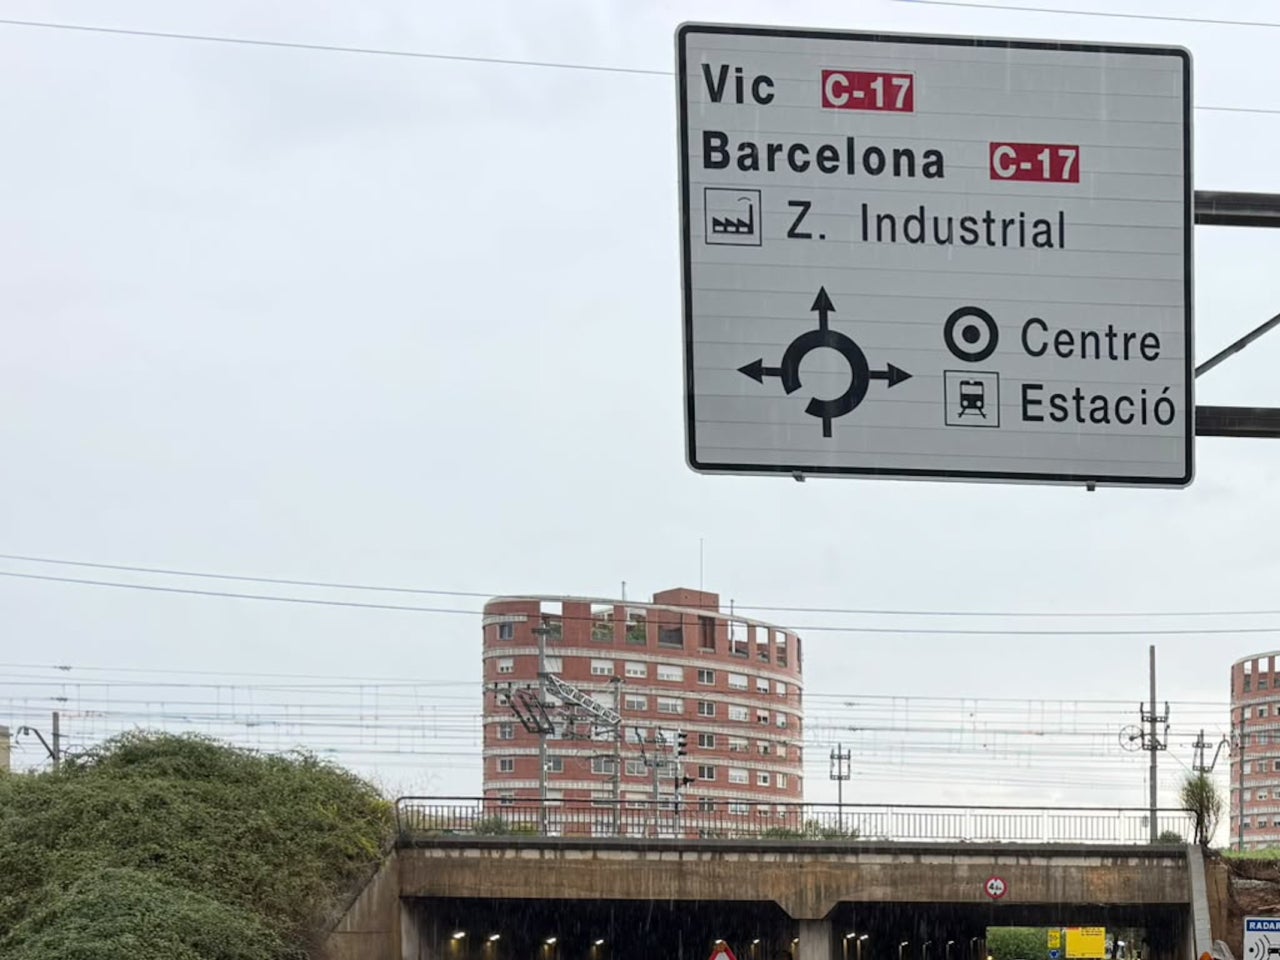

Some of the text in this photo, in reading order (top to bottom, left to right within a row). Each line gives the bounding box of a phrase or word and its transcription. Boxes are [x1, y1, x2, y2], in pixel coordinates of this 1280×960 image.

[701, 63, 911, 109] Vic C-17
[702, 130, 1077, 181] Barcelona C-17
[786, 200, 1065, 249] Z. Industrial
[1021, 318, 1161, 361] Centre
[1021, 383, 1176, 426] Estació
